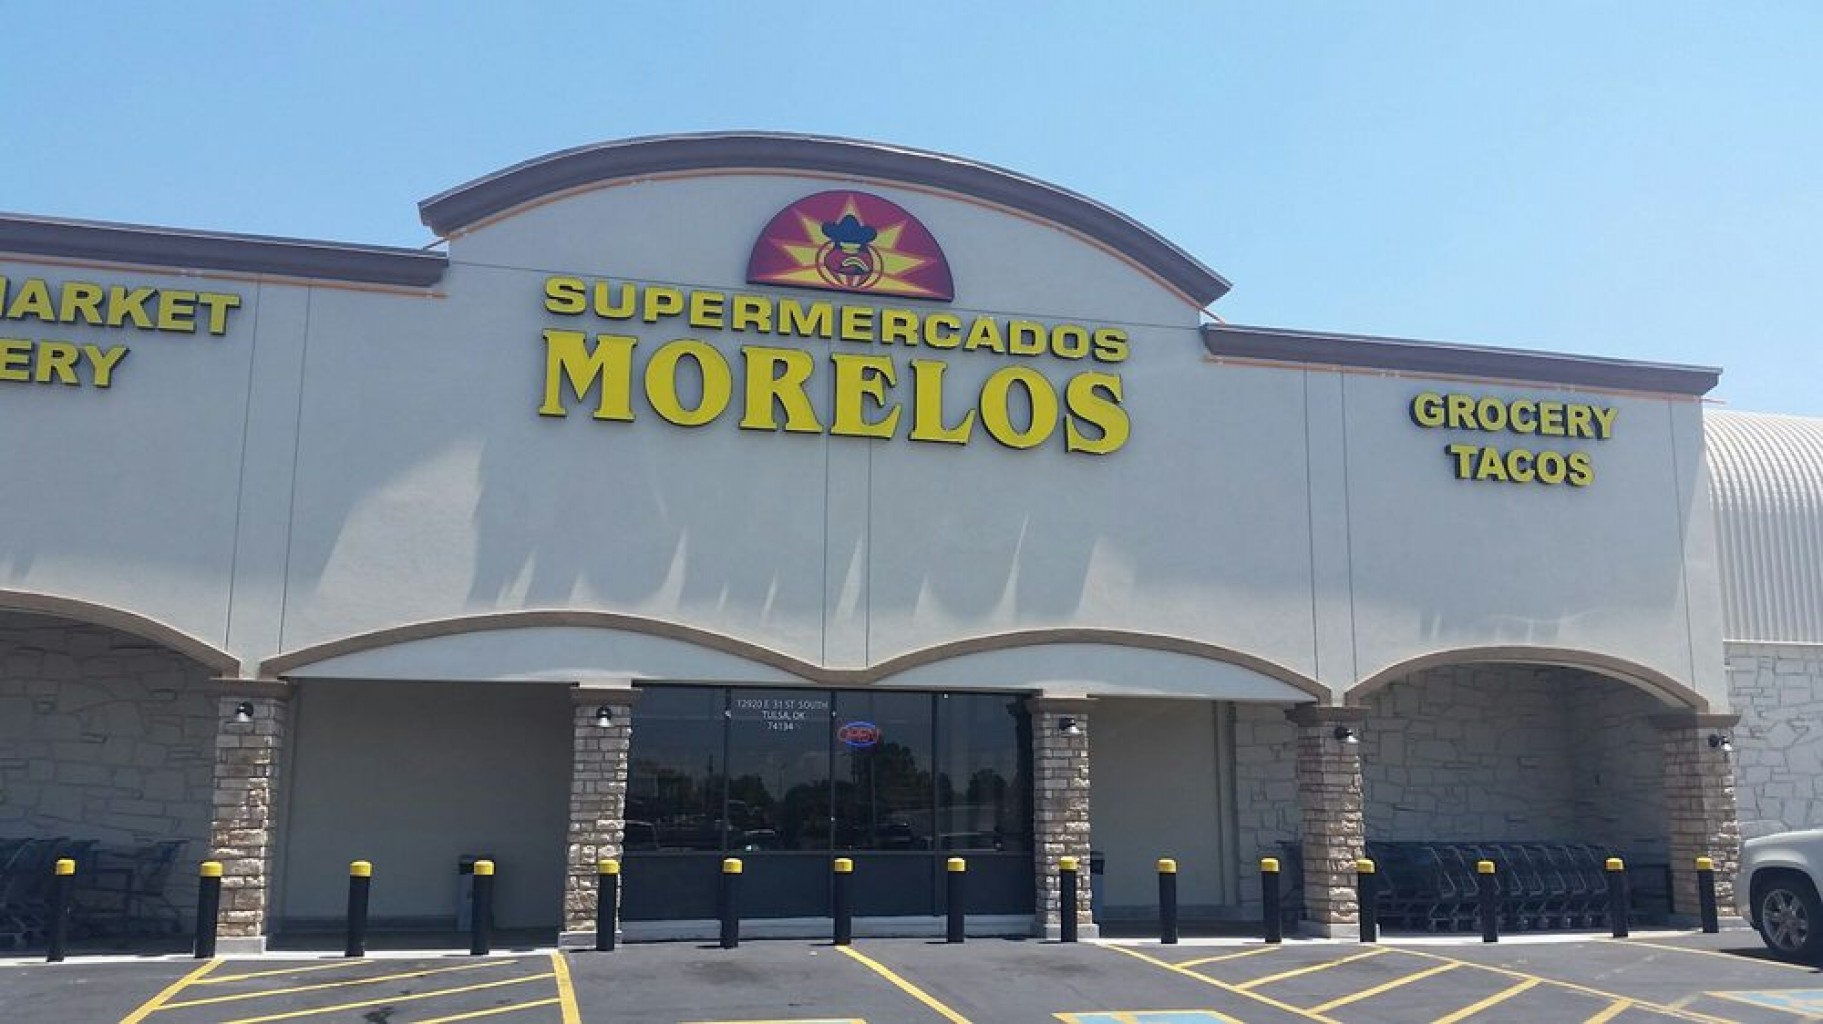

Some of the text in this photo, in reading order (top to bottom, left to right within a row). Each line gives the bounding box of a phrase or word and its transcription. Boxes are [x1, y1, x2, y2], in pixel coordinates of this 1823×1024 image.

[0, 275, 241, 335] ARKET
[543, 275, 1130, 362] SUPERMERCADOS
[539, 328, 1132, 455] MORELOS
[1411, 391, 1618, 439] GROCERY
[1446, 443, 1595, 487] TACOS
[737, 699, 763, 709] 12920
[797, 700, 829, 710] SOUTH
[793, 711, 805, 720] OK
[838, 727, 879, 742] OPEN
